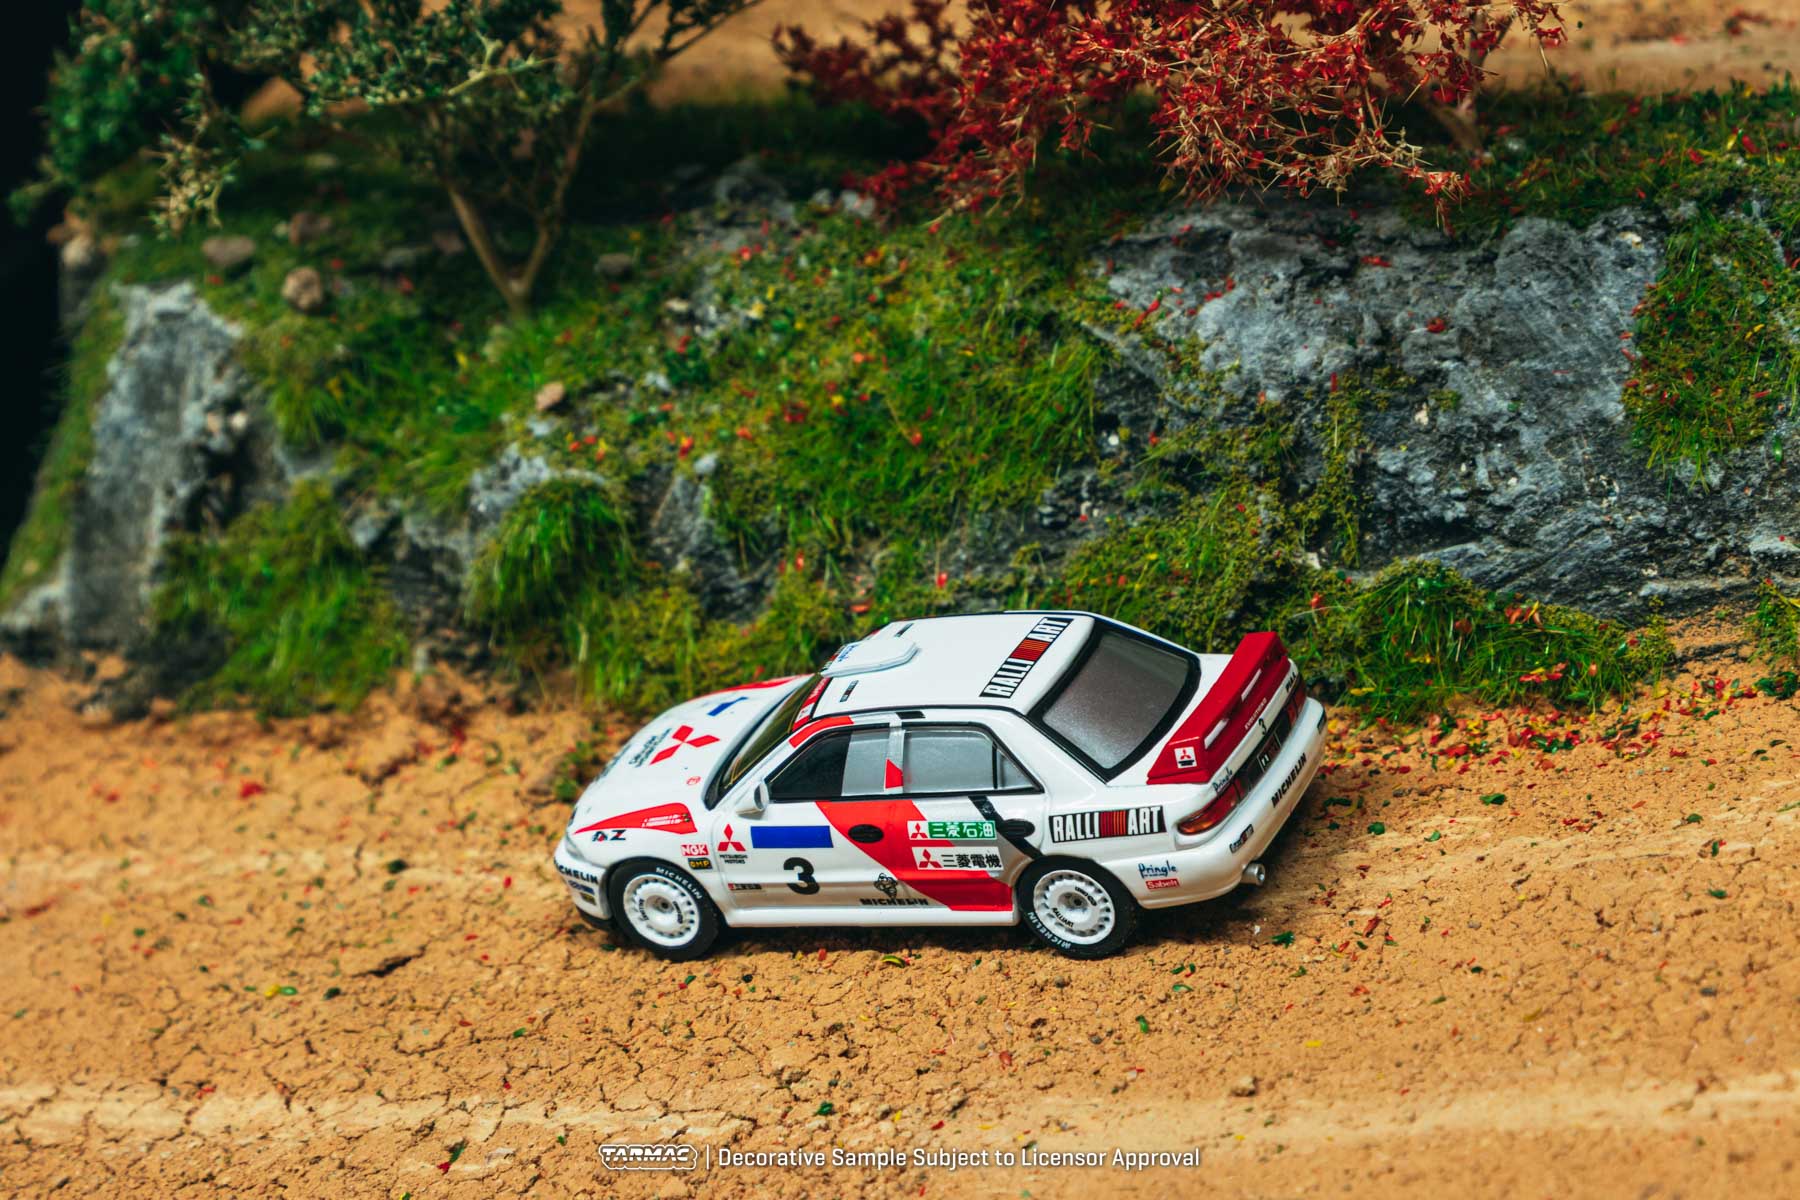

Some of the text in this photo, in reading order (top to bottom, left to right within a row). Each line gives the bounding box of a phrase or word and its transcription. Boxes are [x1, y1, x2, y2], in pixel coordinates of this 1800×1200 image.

[1271, 752, 1307, 809] MICHELIN
[931, 822, 994, 838] 三菱石油
[681, 844, 707, 856] NGK
[941, 853, 1002, 868] 三菱電機
[655, 866, 703, 900] MICHELIN
[783, 857, 820, 895] 3
[859, 898, 929, 906] MICHELIN
[1027, 911, 1072, 949] MICHELIN
